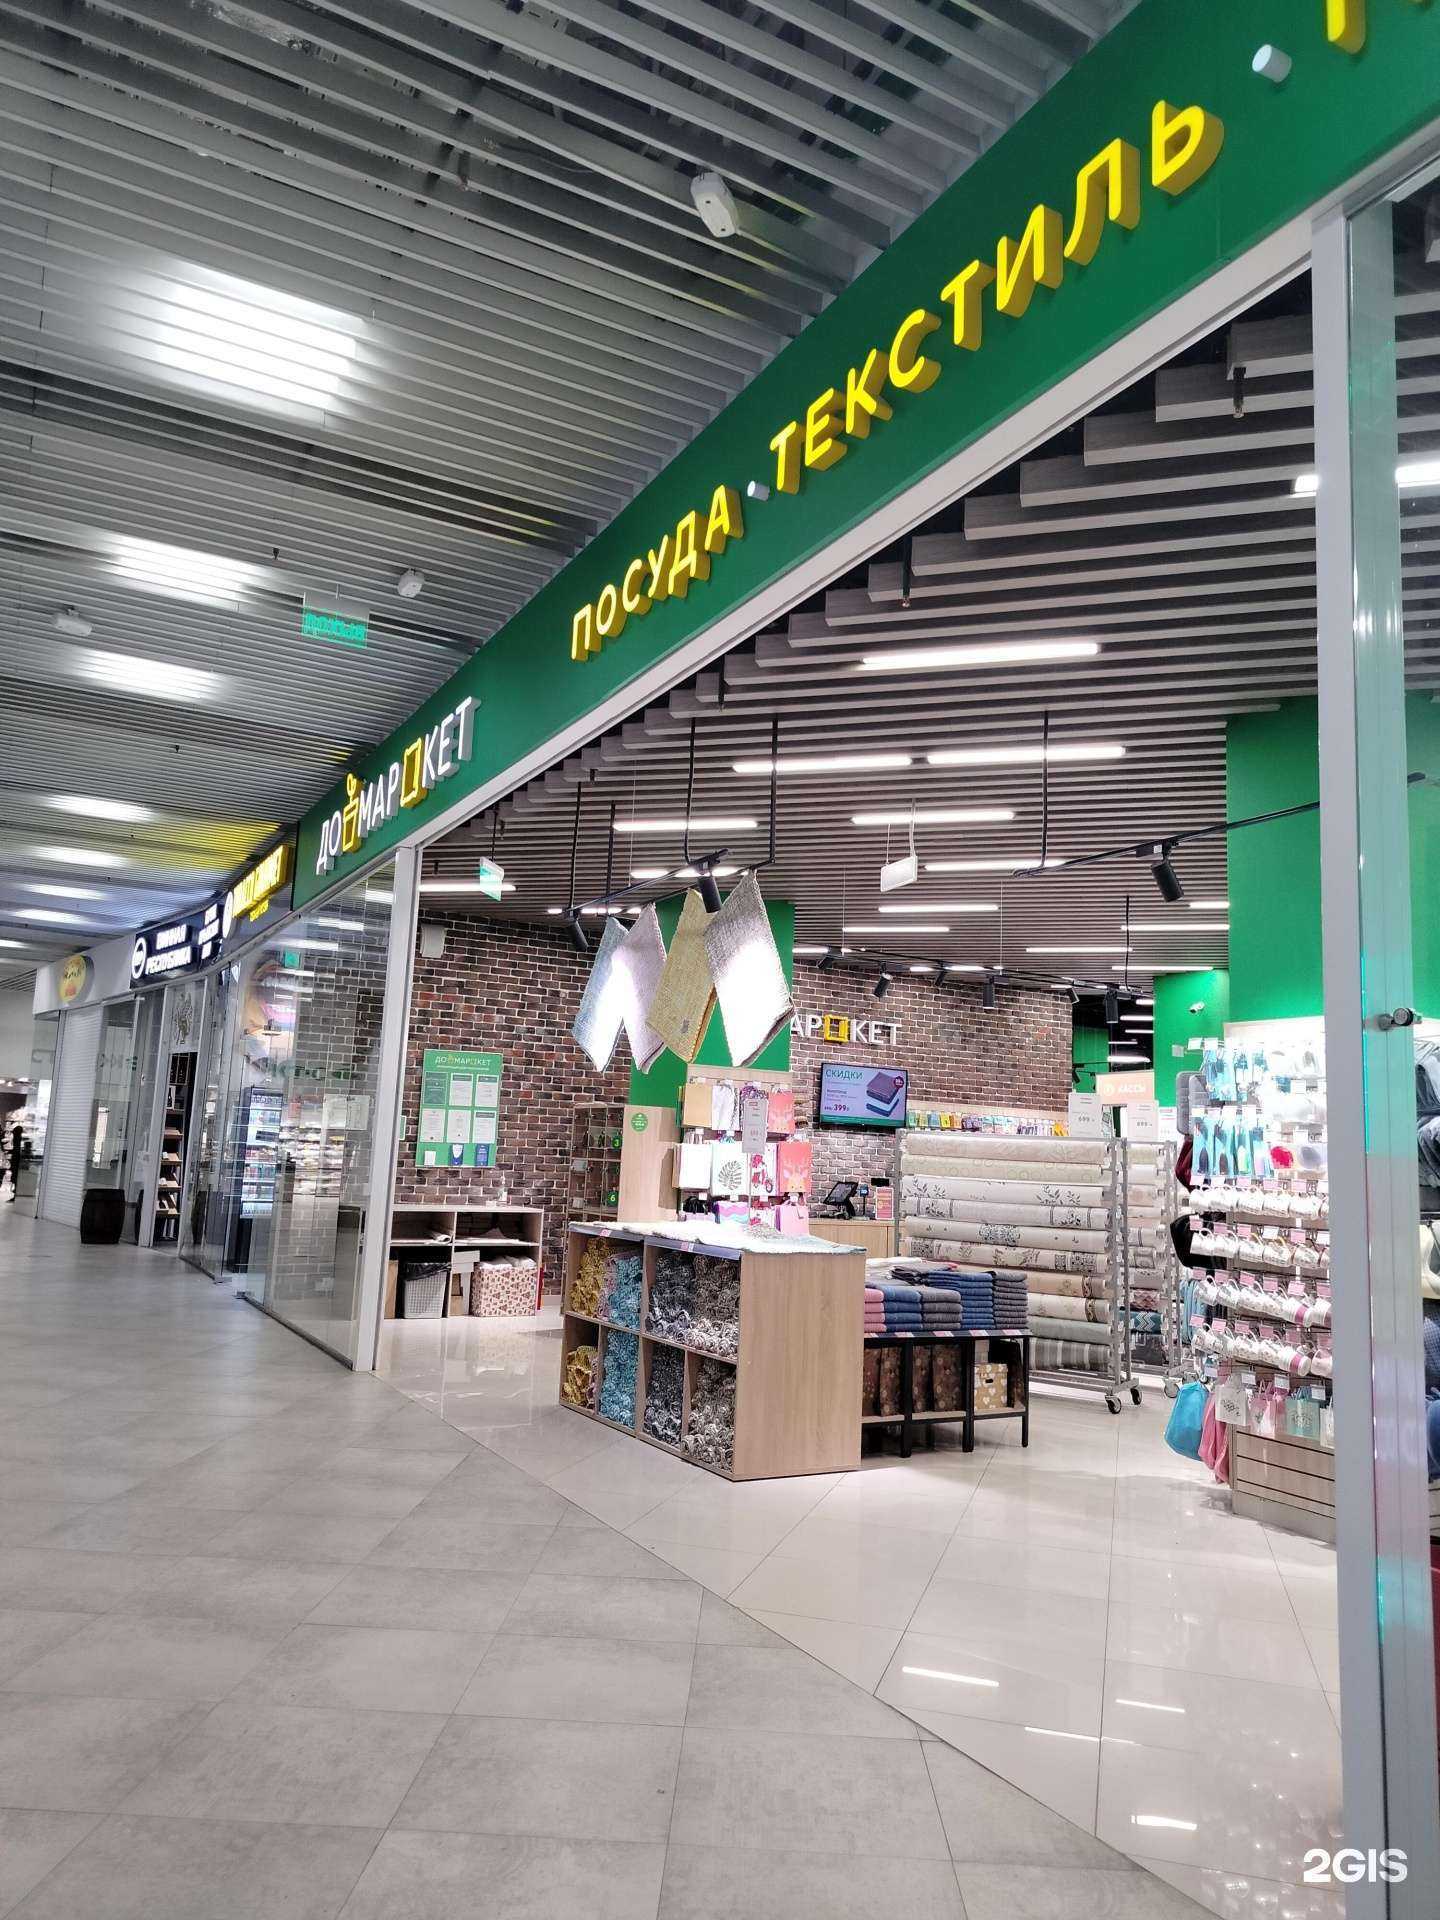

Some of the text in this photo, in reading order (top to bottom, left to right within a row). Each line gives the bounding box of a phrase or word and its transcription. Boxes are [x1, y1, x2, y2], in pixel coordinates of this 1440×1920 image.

[569, 99, 1225, 663] ПОСУДА ТЕКСТИЛЬ
[825, 1069, 863, 1080] СКИДКИ
